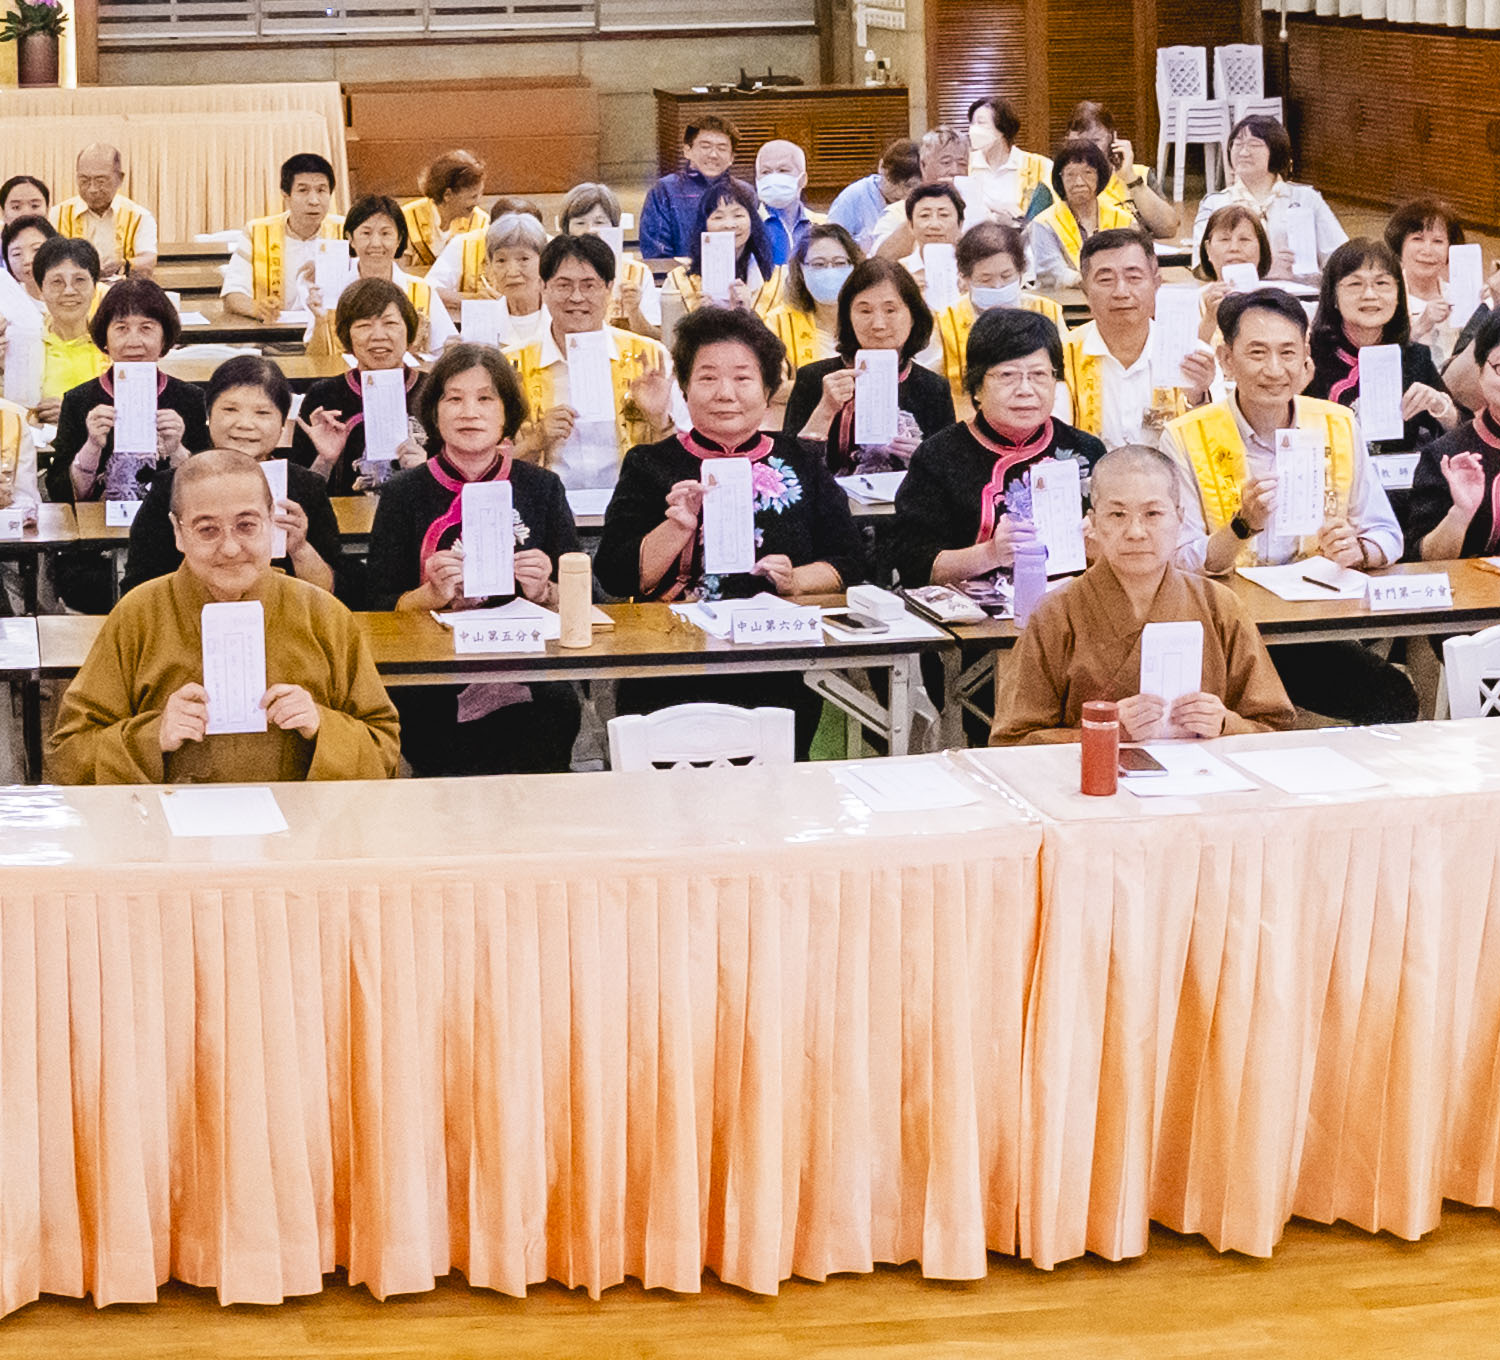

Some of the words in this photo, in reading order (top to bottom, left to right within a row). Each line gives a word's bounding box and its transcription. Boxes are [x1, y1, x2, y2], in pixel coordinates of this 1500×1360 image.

[1373, 584, 1448, 601] 普門第一分會
[736, 616, 820, 633] 中山第六分會
[458, 628, 542, 643] 中山第五分會
